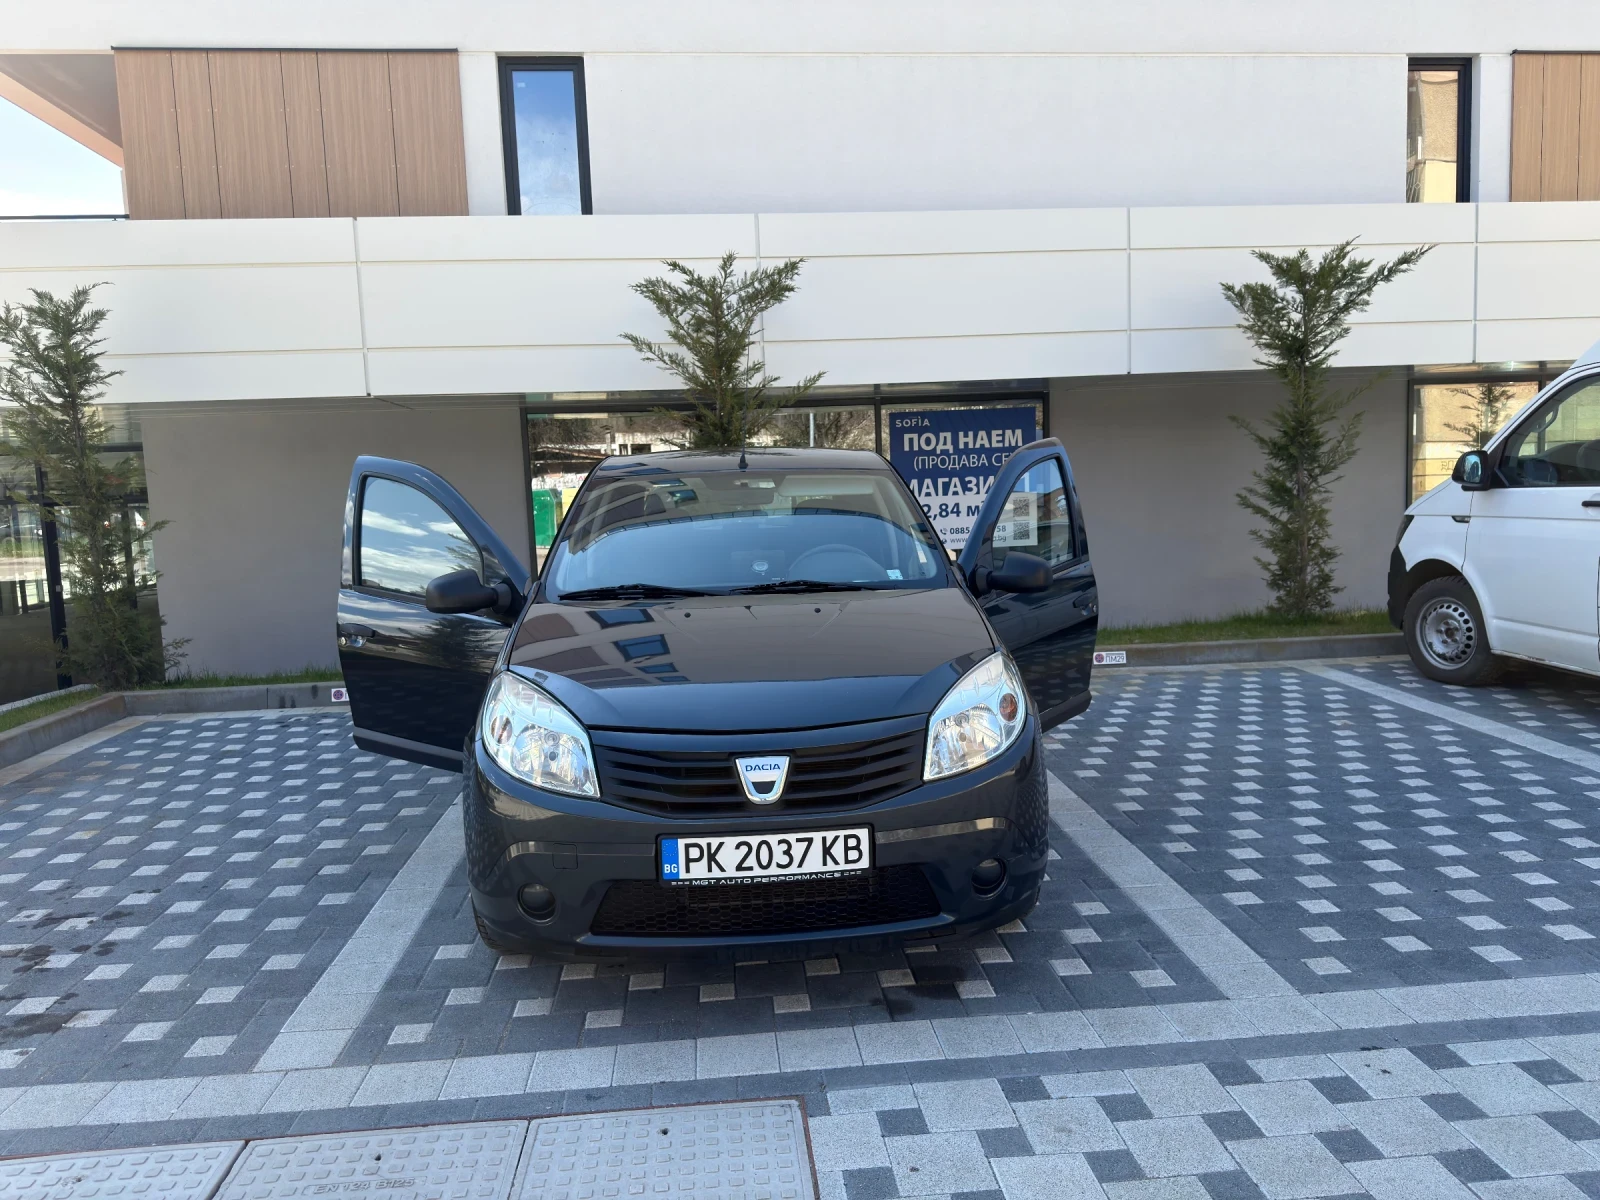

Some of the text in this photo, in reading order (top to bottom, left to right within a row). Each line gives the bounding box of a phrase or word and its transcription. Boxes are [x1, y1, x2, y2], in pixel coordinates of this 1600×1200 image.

[903, 429, 1023, 454] ПОД НАЕМ
[913, 452, 1012, 471] (ПРОДАВА СЕ
[966, 501, 985, 517] м
[949, 527, 970, 535] 0885
[745, 763, 781, 772] DACIA
[684, 833, 864, 874] PK 2037 KB
[664, 864, 678, 874] BG
[719, 877, 751, 886] AUTO
[753, 871, 842, 884] PERFORMANCE
